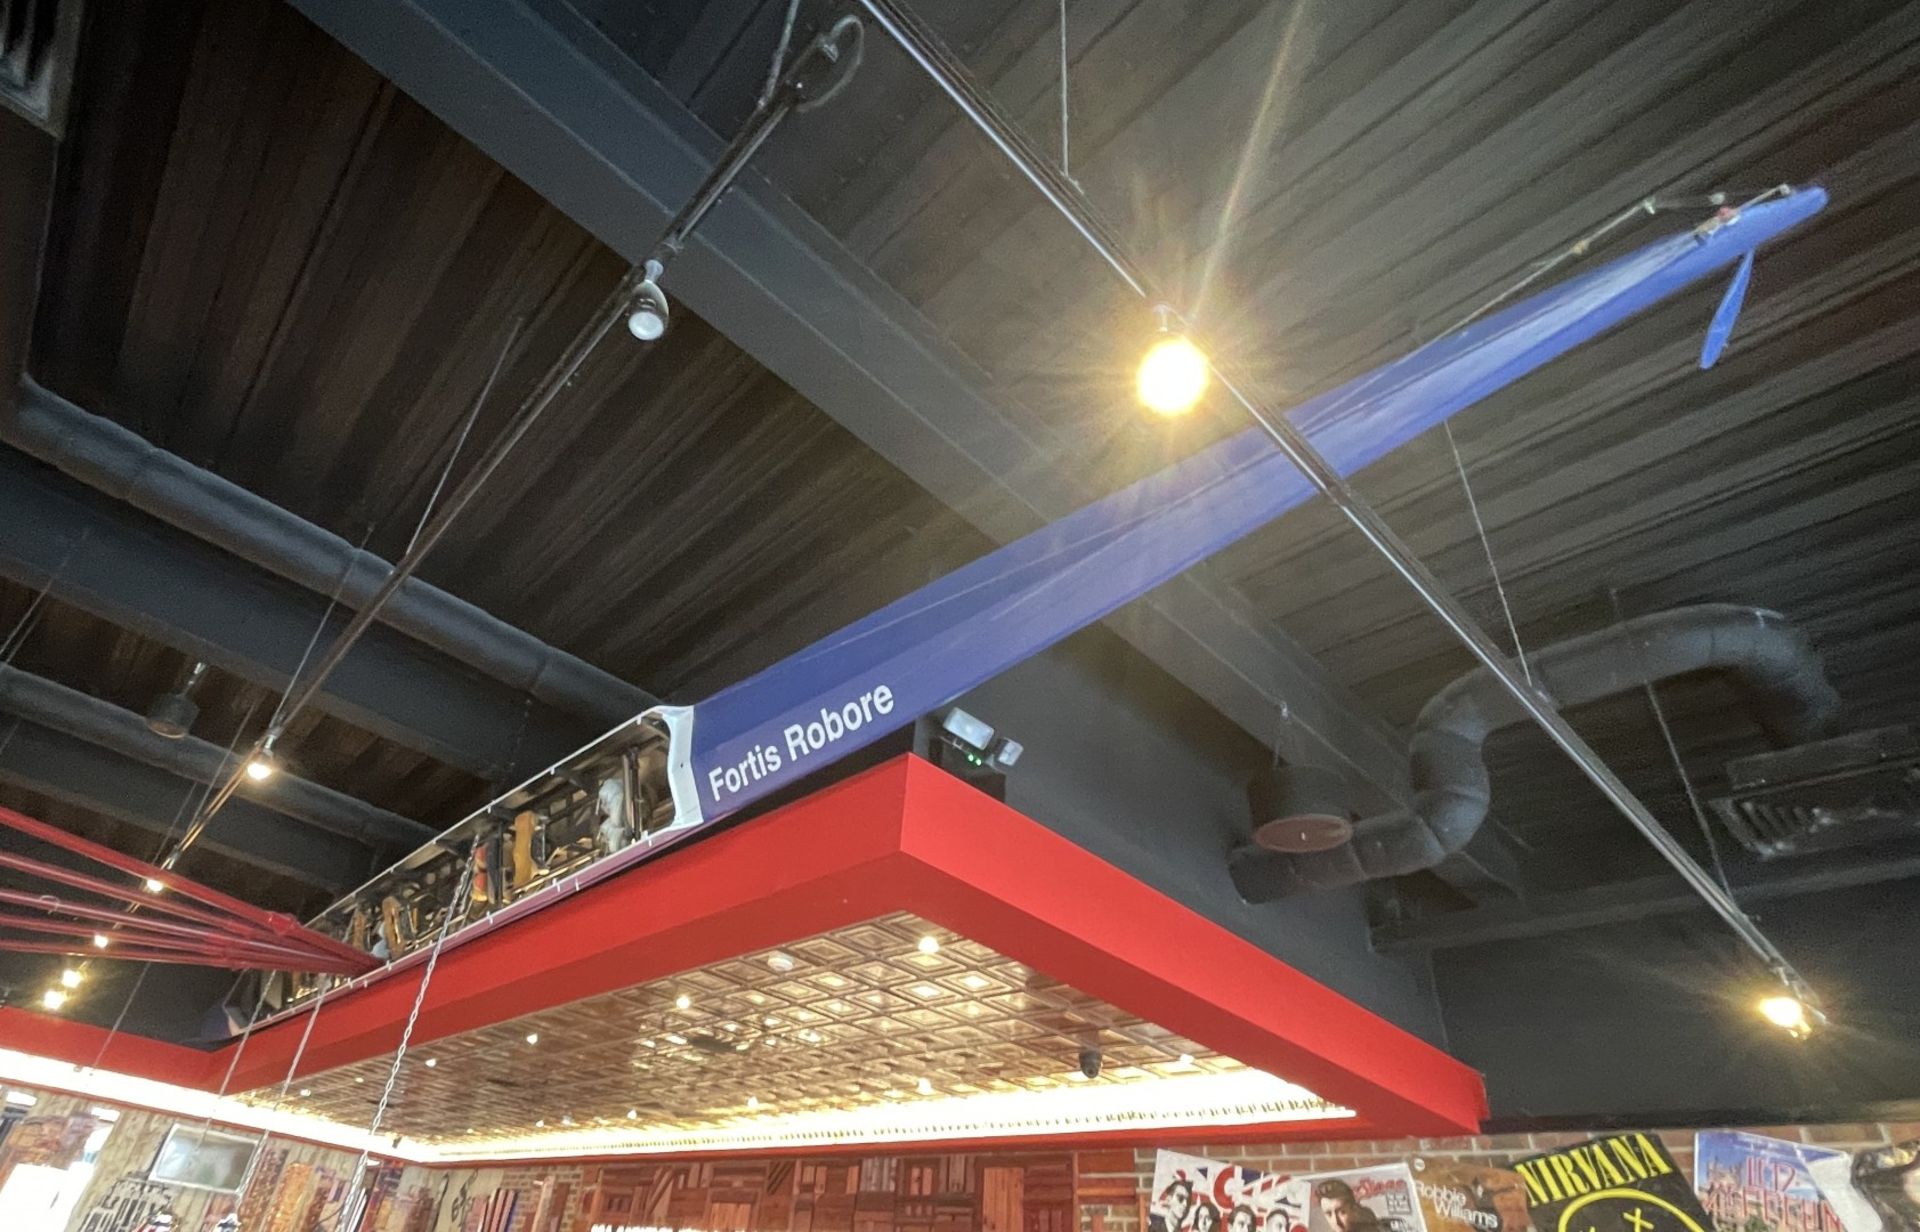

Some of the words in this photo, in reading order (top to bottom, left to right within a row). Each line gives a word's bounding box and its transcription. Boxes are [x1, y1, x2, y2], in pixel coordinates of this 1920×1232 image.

[708, 744, 782, 801] Fortis
[783, 685, 894, 761] Robore
[1415, 1180, 1466, 1207] Robbie
[1514, 1132, 1673, 1207] NIRVANA
[1433, 1199, 1498, 1228] Williams
